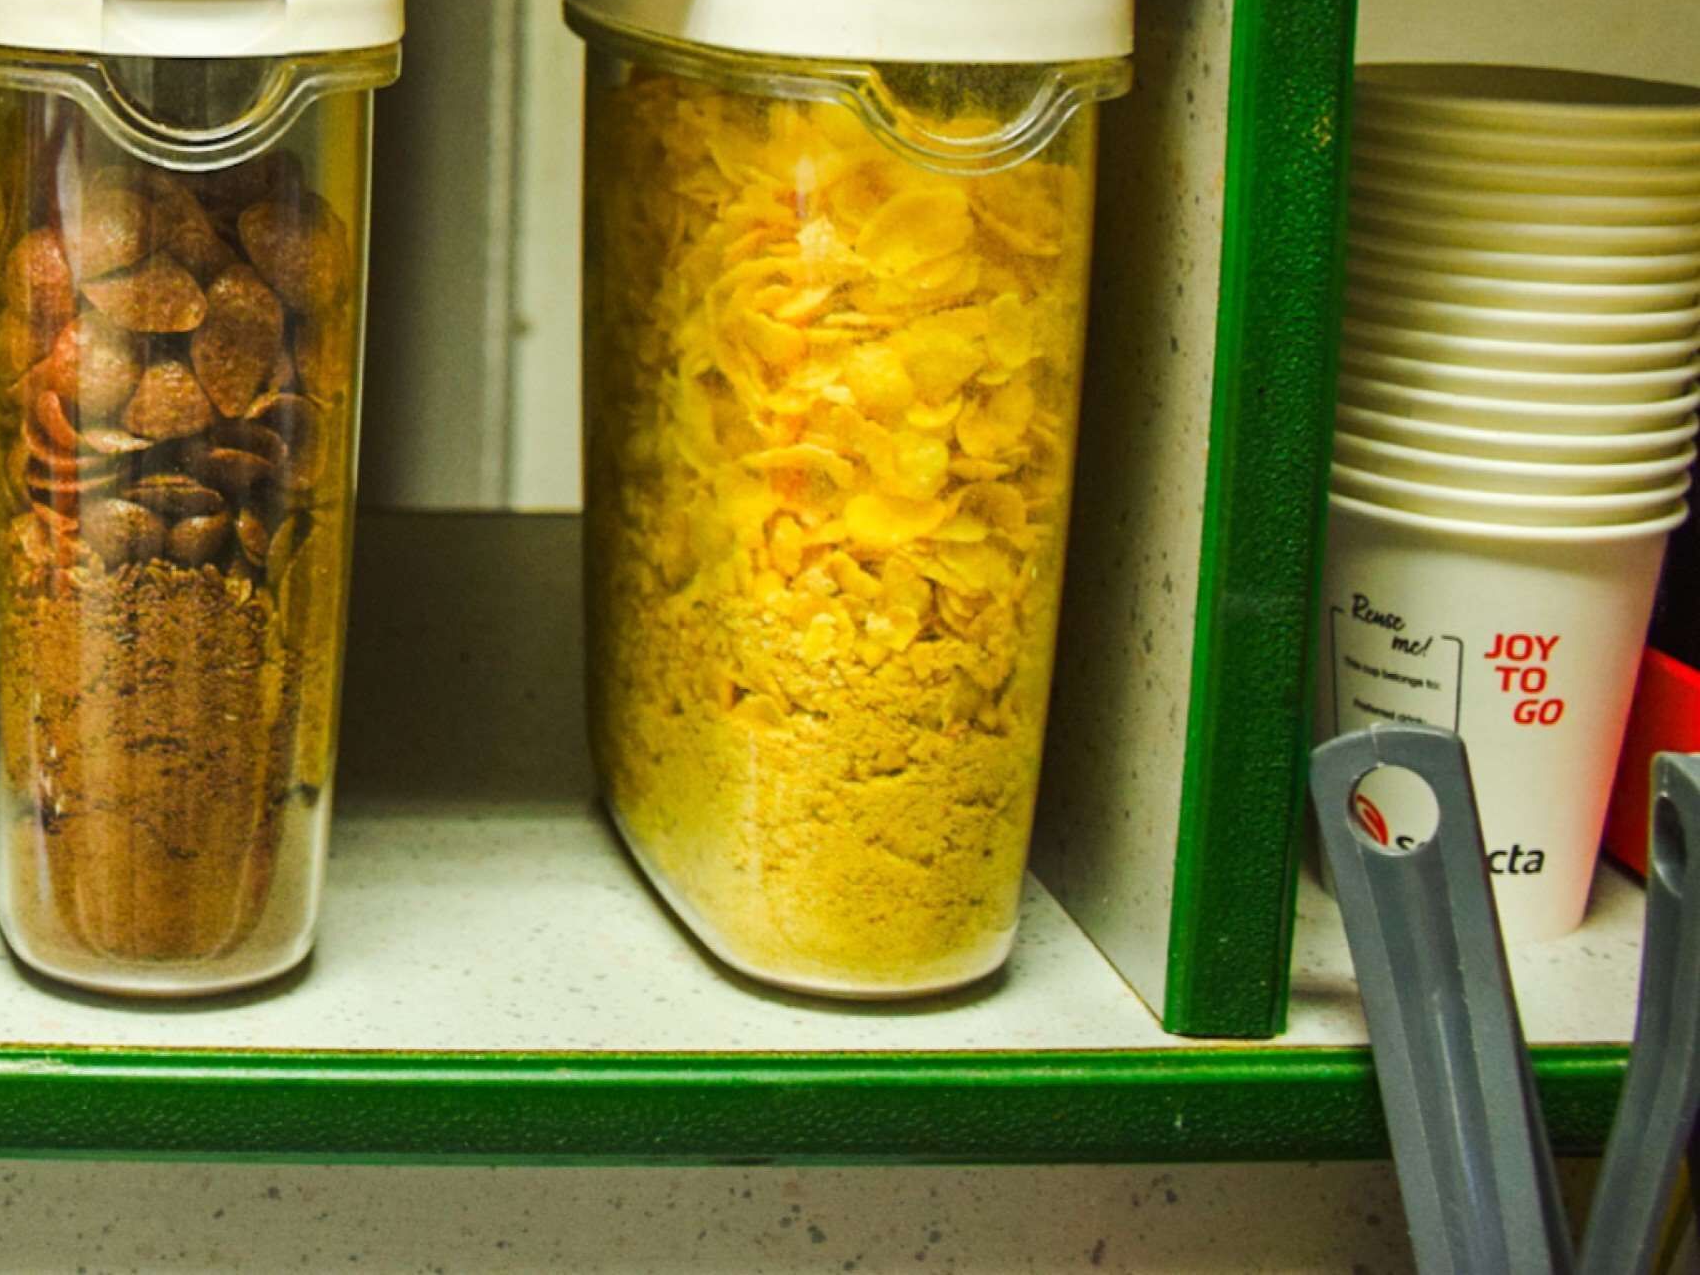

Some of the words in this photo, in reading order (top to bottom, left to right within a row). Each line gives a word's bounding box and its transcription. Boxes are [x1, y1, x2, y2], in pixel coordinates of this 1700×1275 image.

[1351, 591, 1407, 632] Reuse
[1390, 635, 1434, 658] me!
[1483, 632, 1561, 662] JOY
[1494, 665, 1548, 694] TO
[1512, 697, 1566, 726] GO
